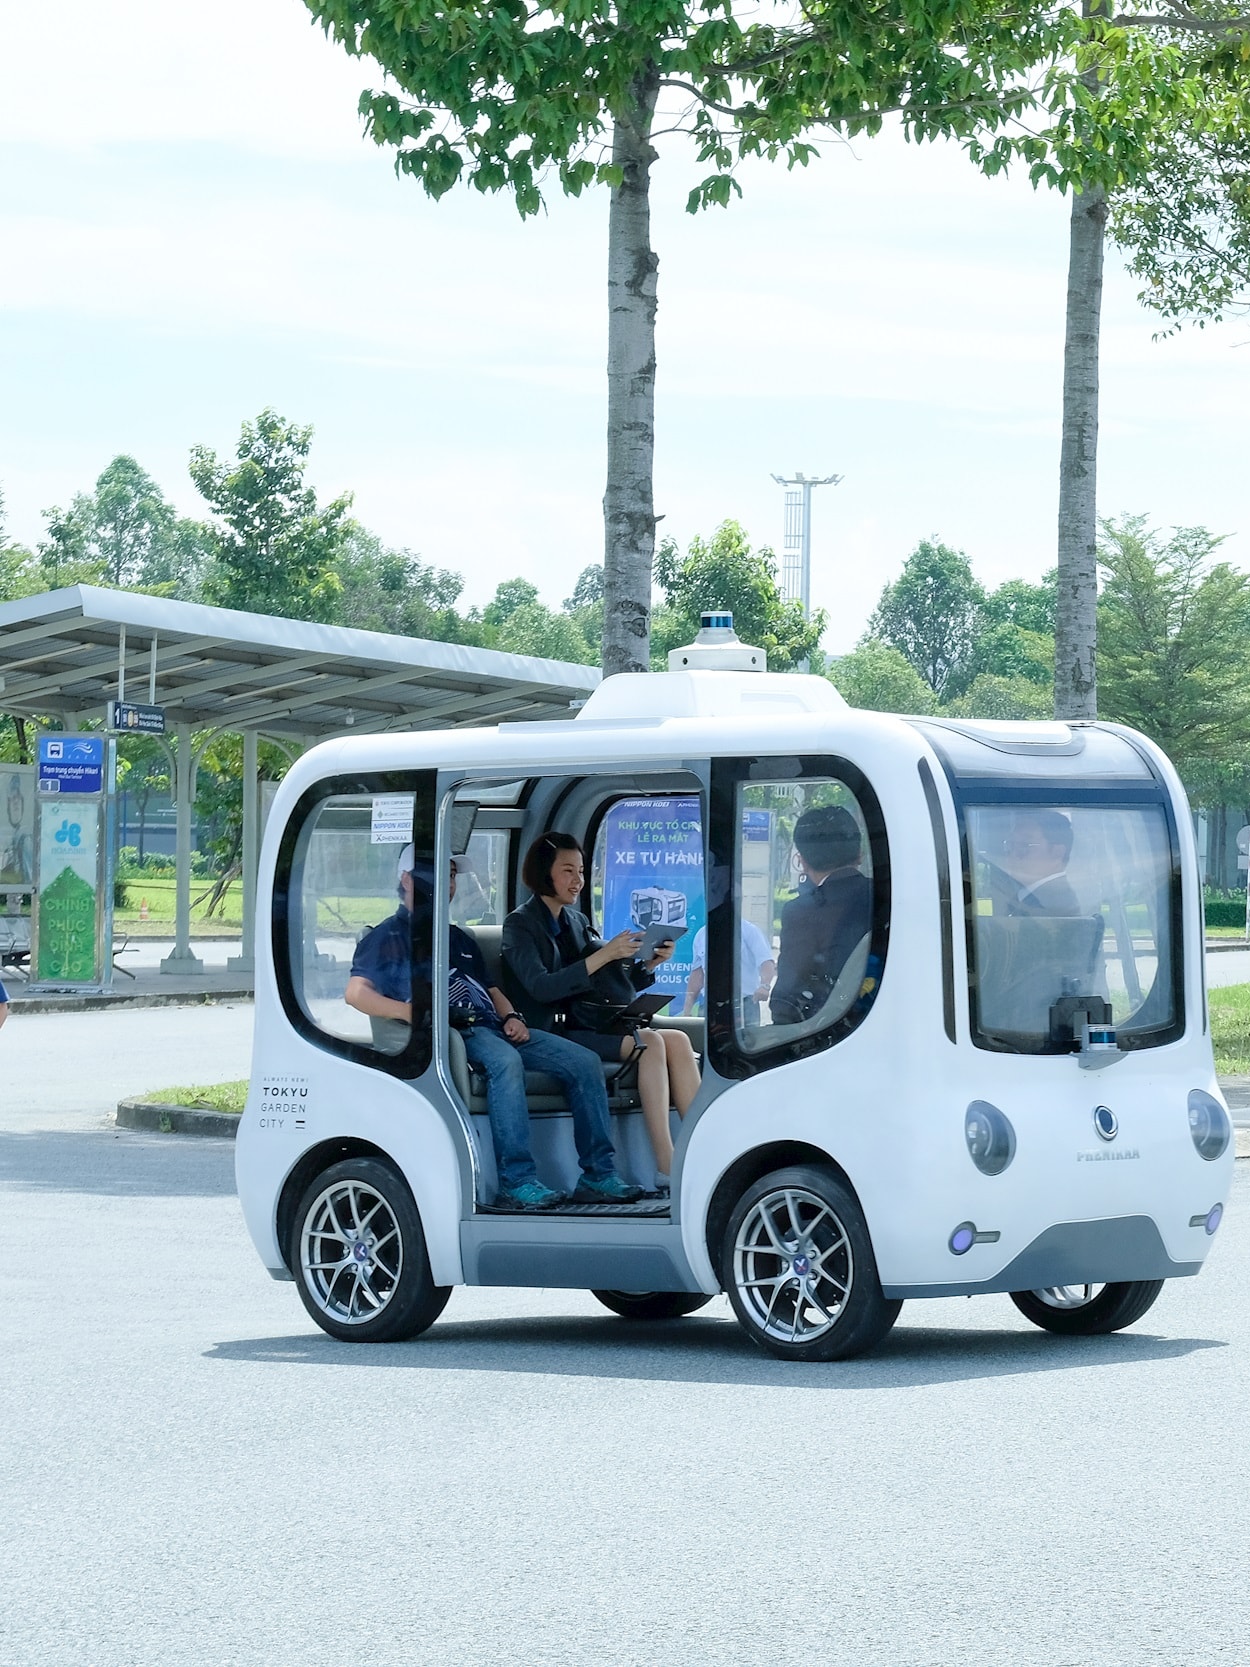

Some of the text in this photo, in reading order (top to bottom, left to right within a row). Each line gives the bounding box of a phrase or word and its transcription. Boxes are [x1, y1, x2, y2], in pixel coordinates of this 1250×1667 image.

[46, 780, 53, 791] 1
[618, 821, 640, 830] KHU
[652, 834, 666, 843] RA
[615, 851, 636, 864] XE
[639, 849, 661, 867] TỰ
[263, 1087, 308, 1097] TOKYU
[260, 1102, 306, 1113] GARDEN
[259, 1118, 284, 1128] CITY
